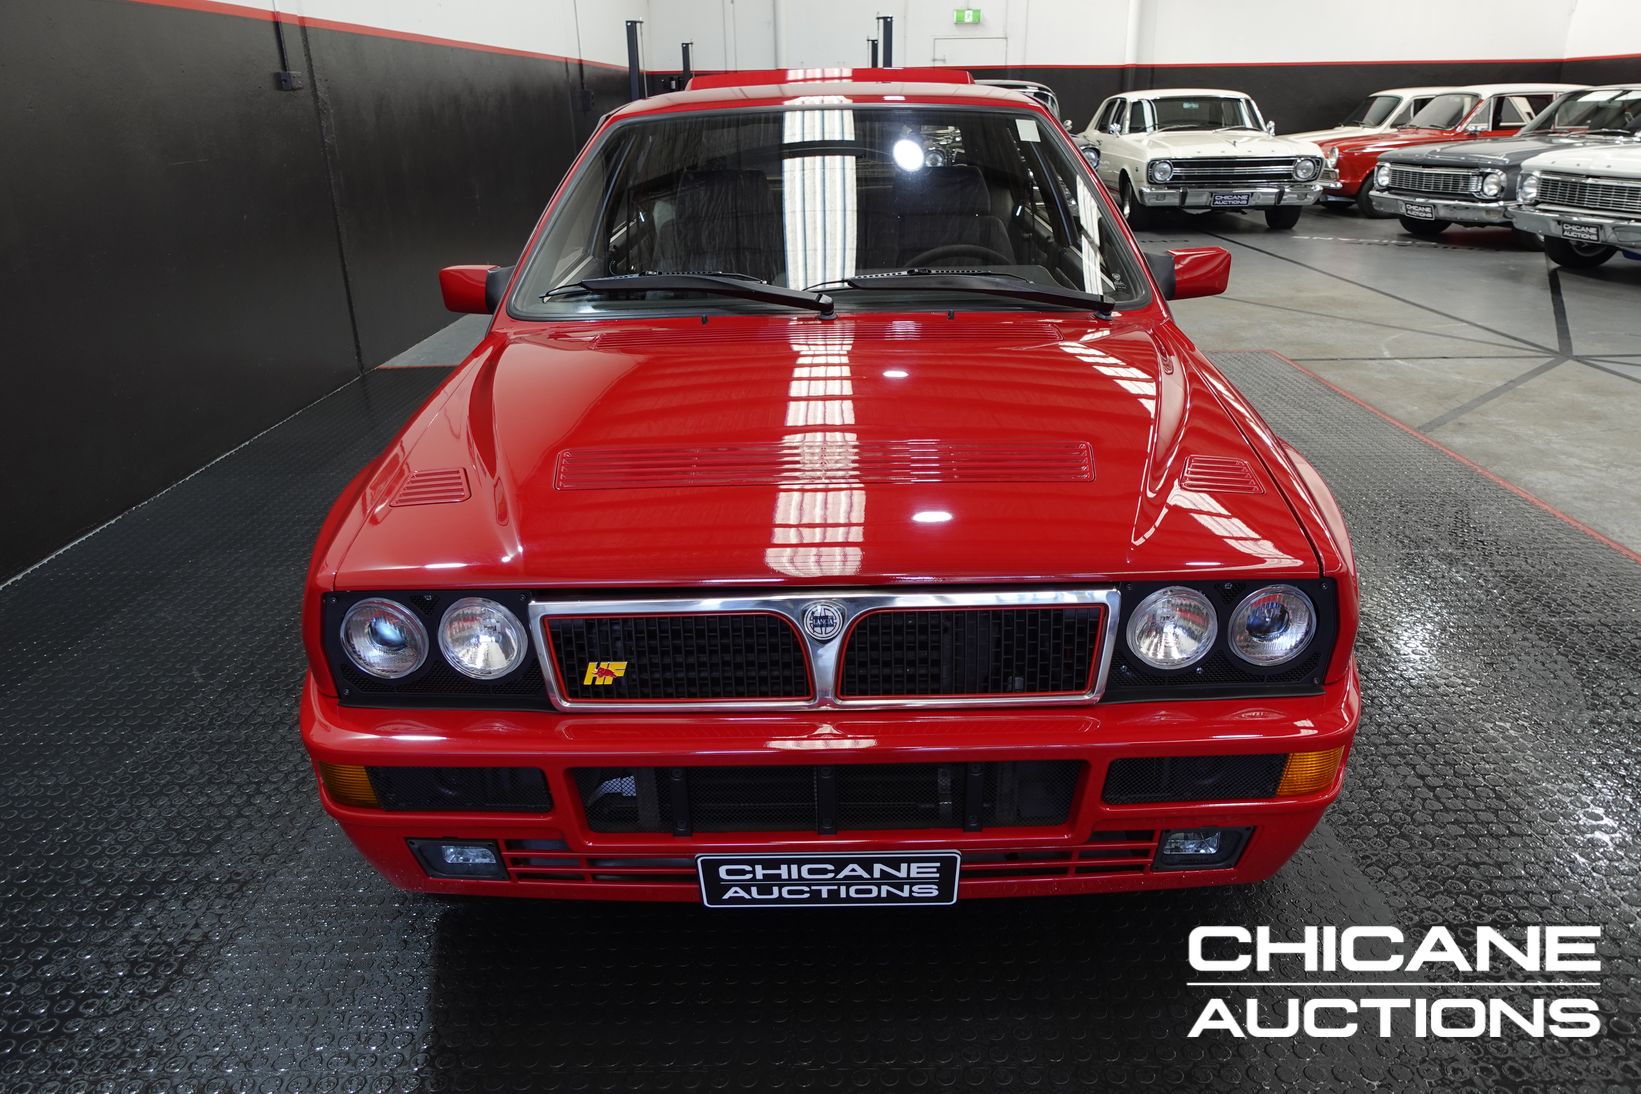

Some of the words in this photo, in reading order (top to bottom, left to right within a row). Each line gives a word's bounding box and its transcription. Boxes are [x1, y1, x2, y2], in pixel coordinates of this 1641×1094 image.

[1406, 204, 1432, 212] CHICANE
[1406, 210, 1433, 218] AUCTIONS
[1563, 223, 1597, 234] CHICANE
[1563, 230, 1598, 241] AUCTIONS
[813, 617, 834, 625] LANCIA
[583, 661, 628, 685] HF
[718, 862, 940, 880] CHICANE
[721, 884, 939, 900] AUCTIONS
